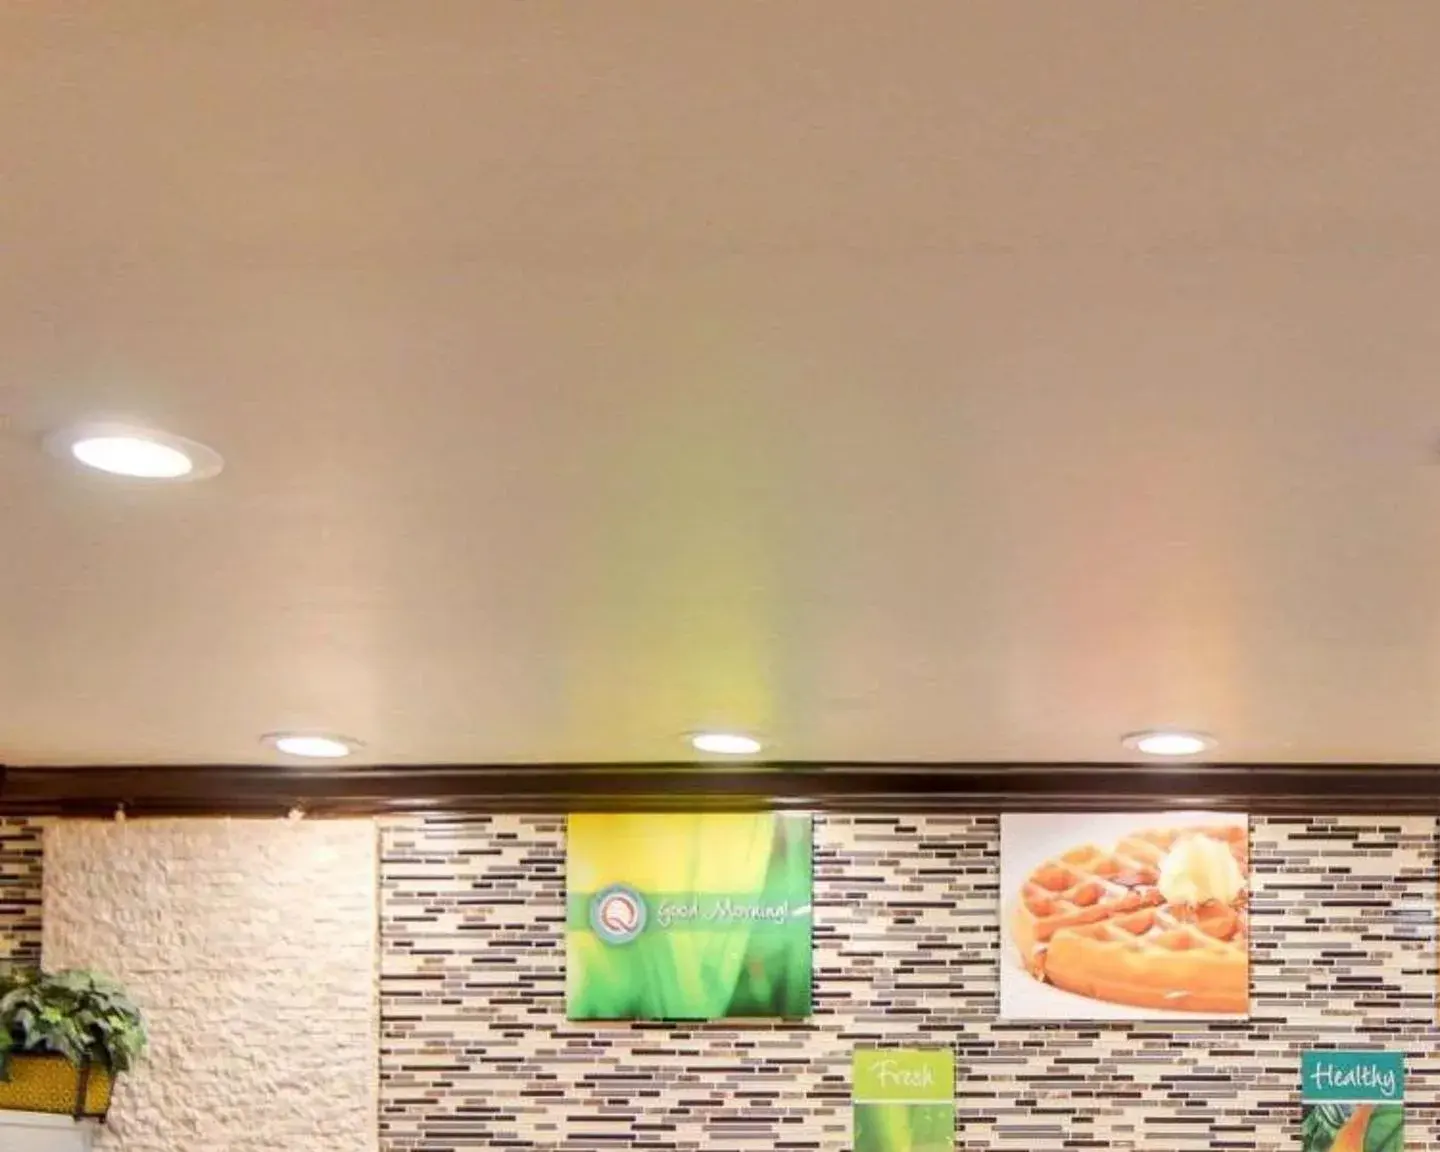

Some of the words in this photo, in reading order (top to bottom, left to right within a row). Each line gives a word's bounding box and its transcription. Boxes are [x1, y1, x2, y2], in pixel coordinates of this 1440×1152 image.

[658, 896, 699, 926] Good
[703, 897, 789, 924] Morning!
[868, 1060, 936, 1088] Fresh
[1310, 1061, 1395, 1096] Healthy
